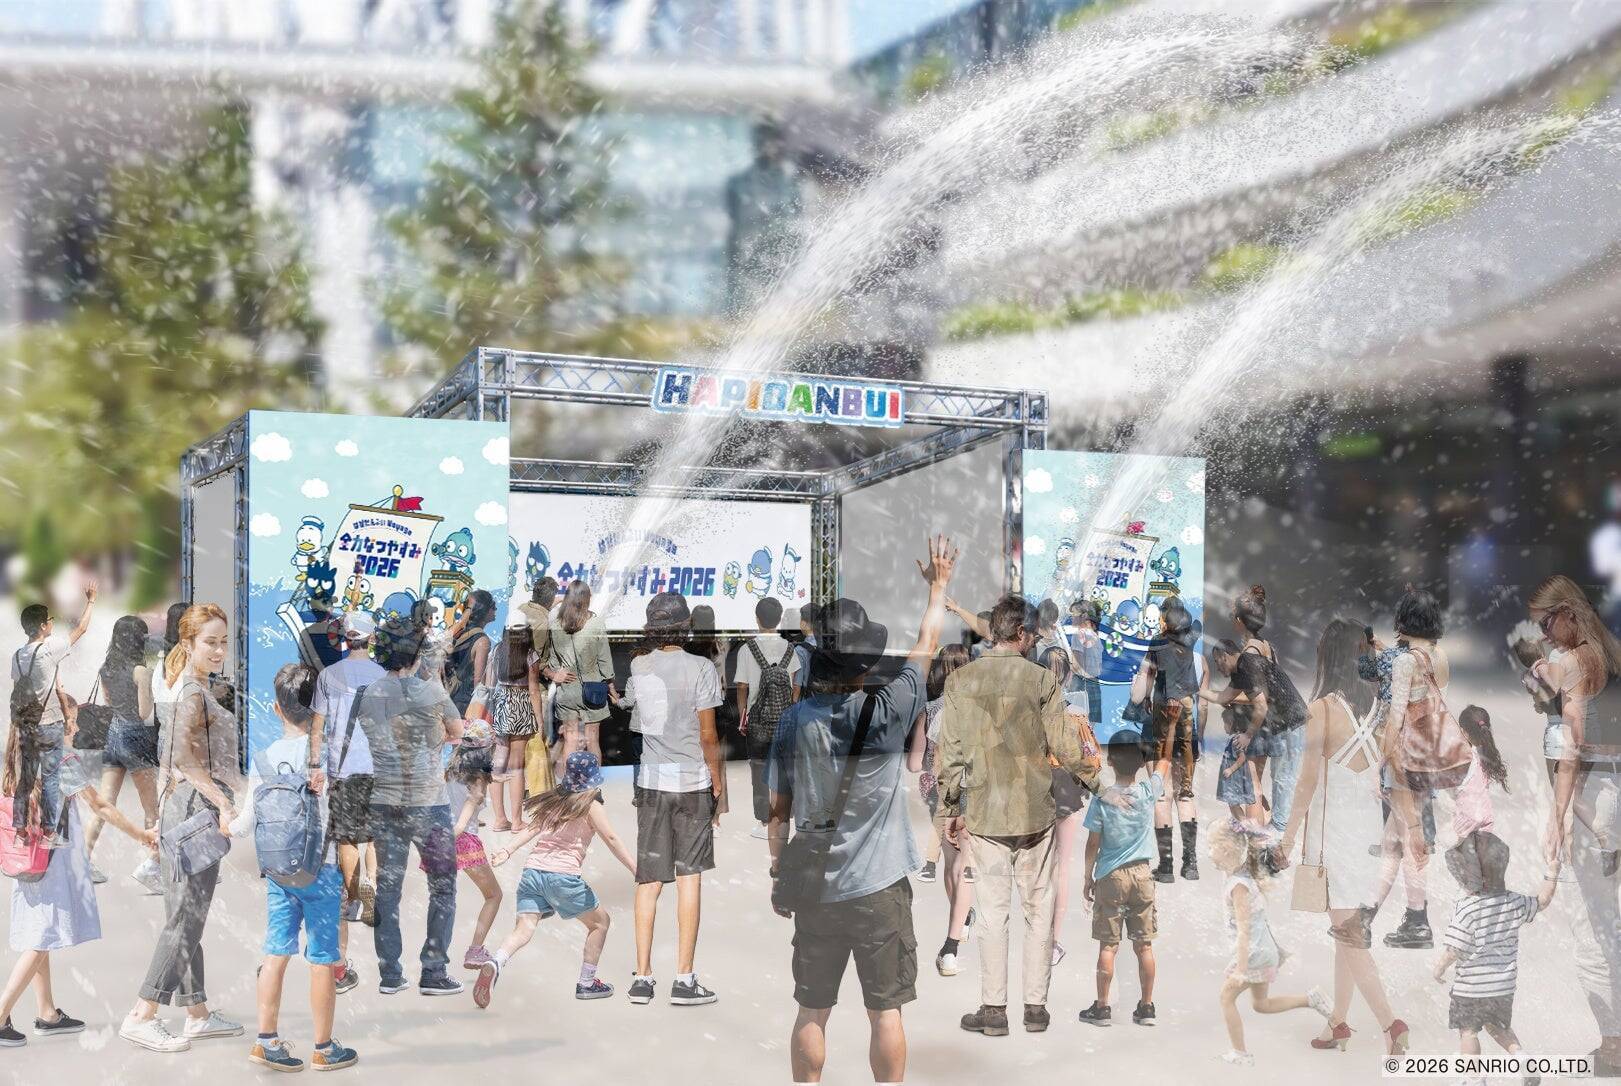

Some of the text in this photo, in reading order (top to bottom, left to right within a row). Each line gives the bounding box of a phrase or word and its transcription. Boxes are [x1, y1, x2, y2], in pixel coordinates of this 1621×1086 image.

[338, 532, 422, 559] 全力なつやすみ
[353, 554, 401, 579] 2026
[1096, 568, 1130, 589] 2026
